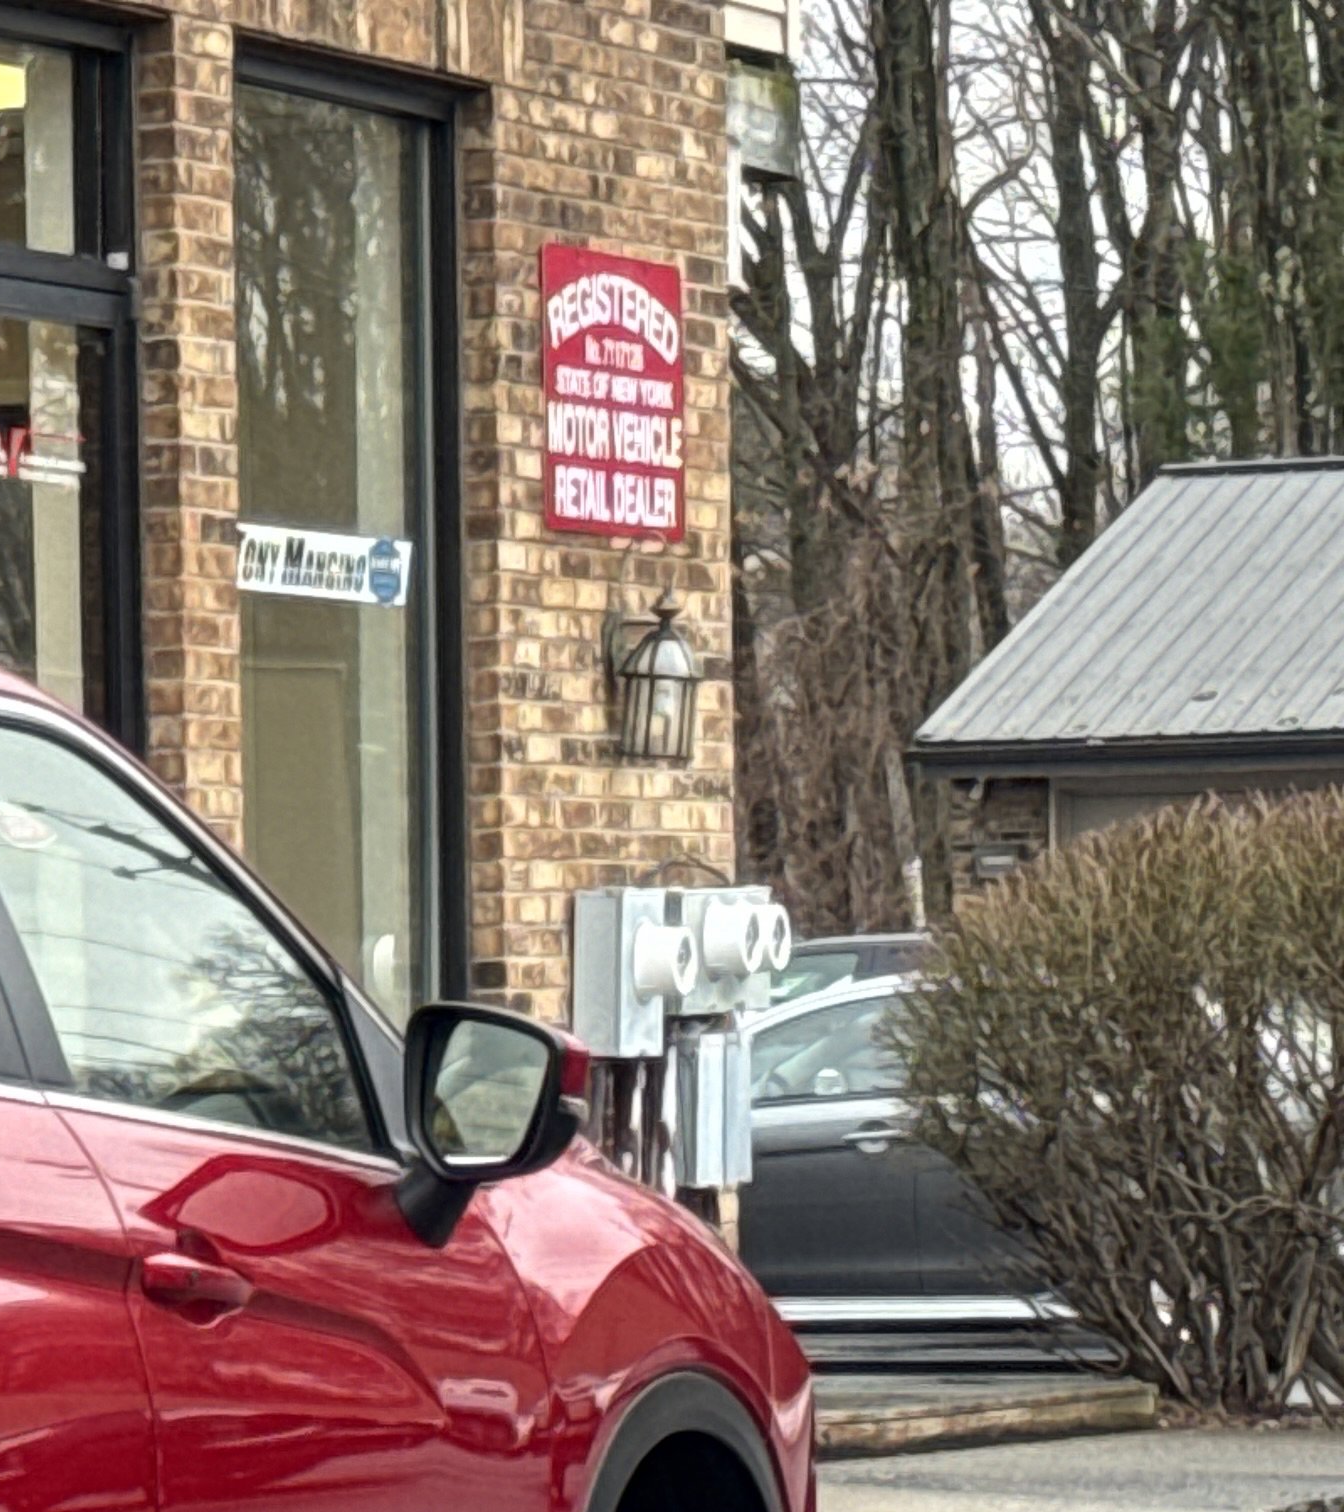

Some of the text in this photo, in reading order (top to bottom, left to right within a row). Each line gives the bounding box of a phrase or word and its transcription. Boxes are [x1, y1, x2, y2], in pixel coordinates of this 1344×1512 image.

[547, 273, 680, 366] REGISTERED
[554, 364, 674, 411] STATE OF NEW YORK
[547, 401, 683, 469] MOTOR VEHICLE
[554, 464, 676, 528] RETAIL DEALER
